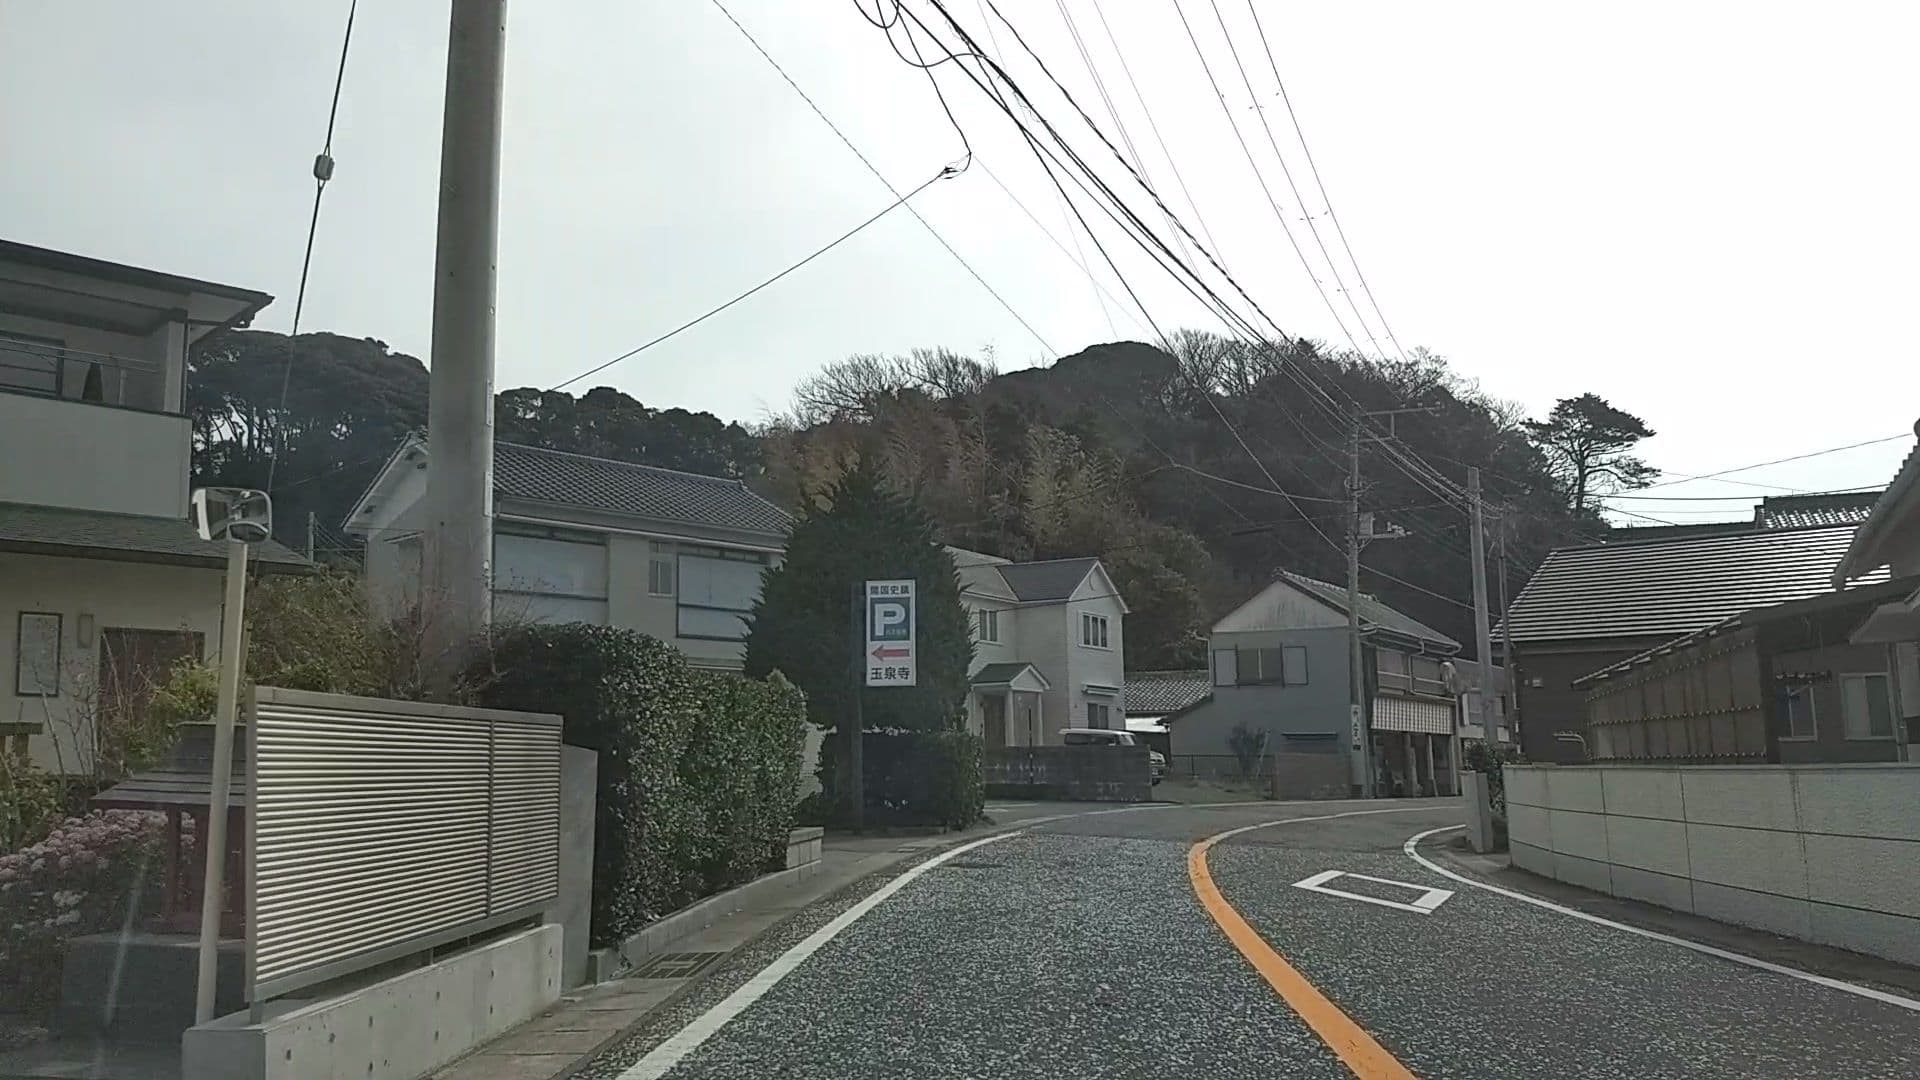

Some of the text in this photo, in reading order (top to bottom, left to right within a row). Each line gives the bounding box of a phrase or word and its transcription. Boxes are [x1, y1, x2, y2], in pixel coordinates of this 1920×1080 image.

[875, 603, 906, 636] P
[871, 667, 910, 680] 玉泉寺
